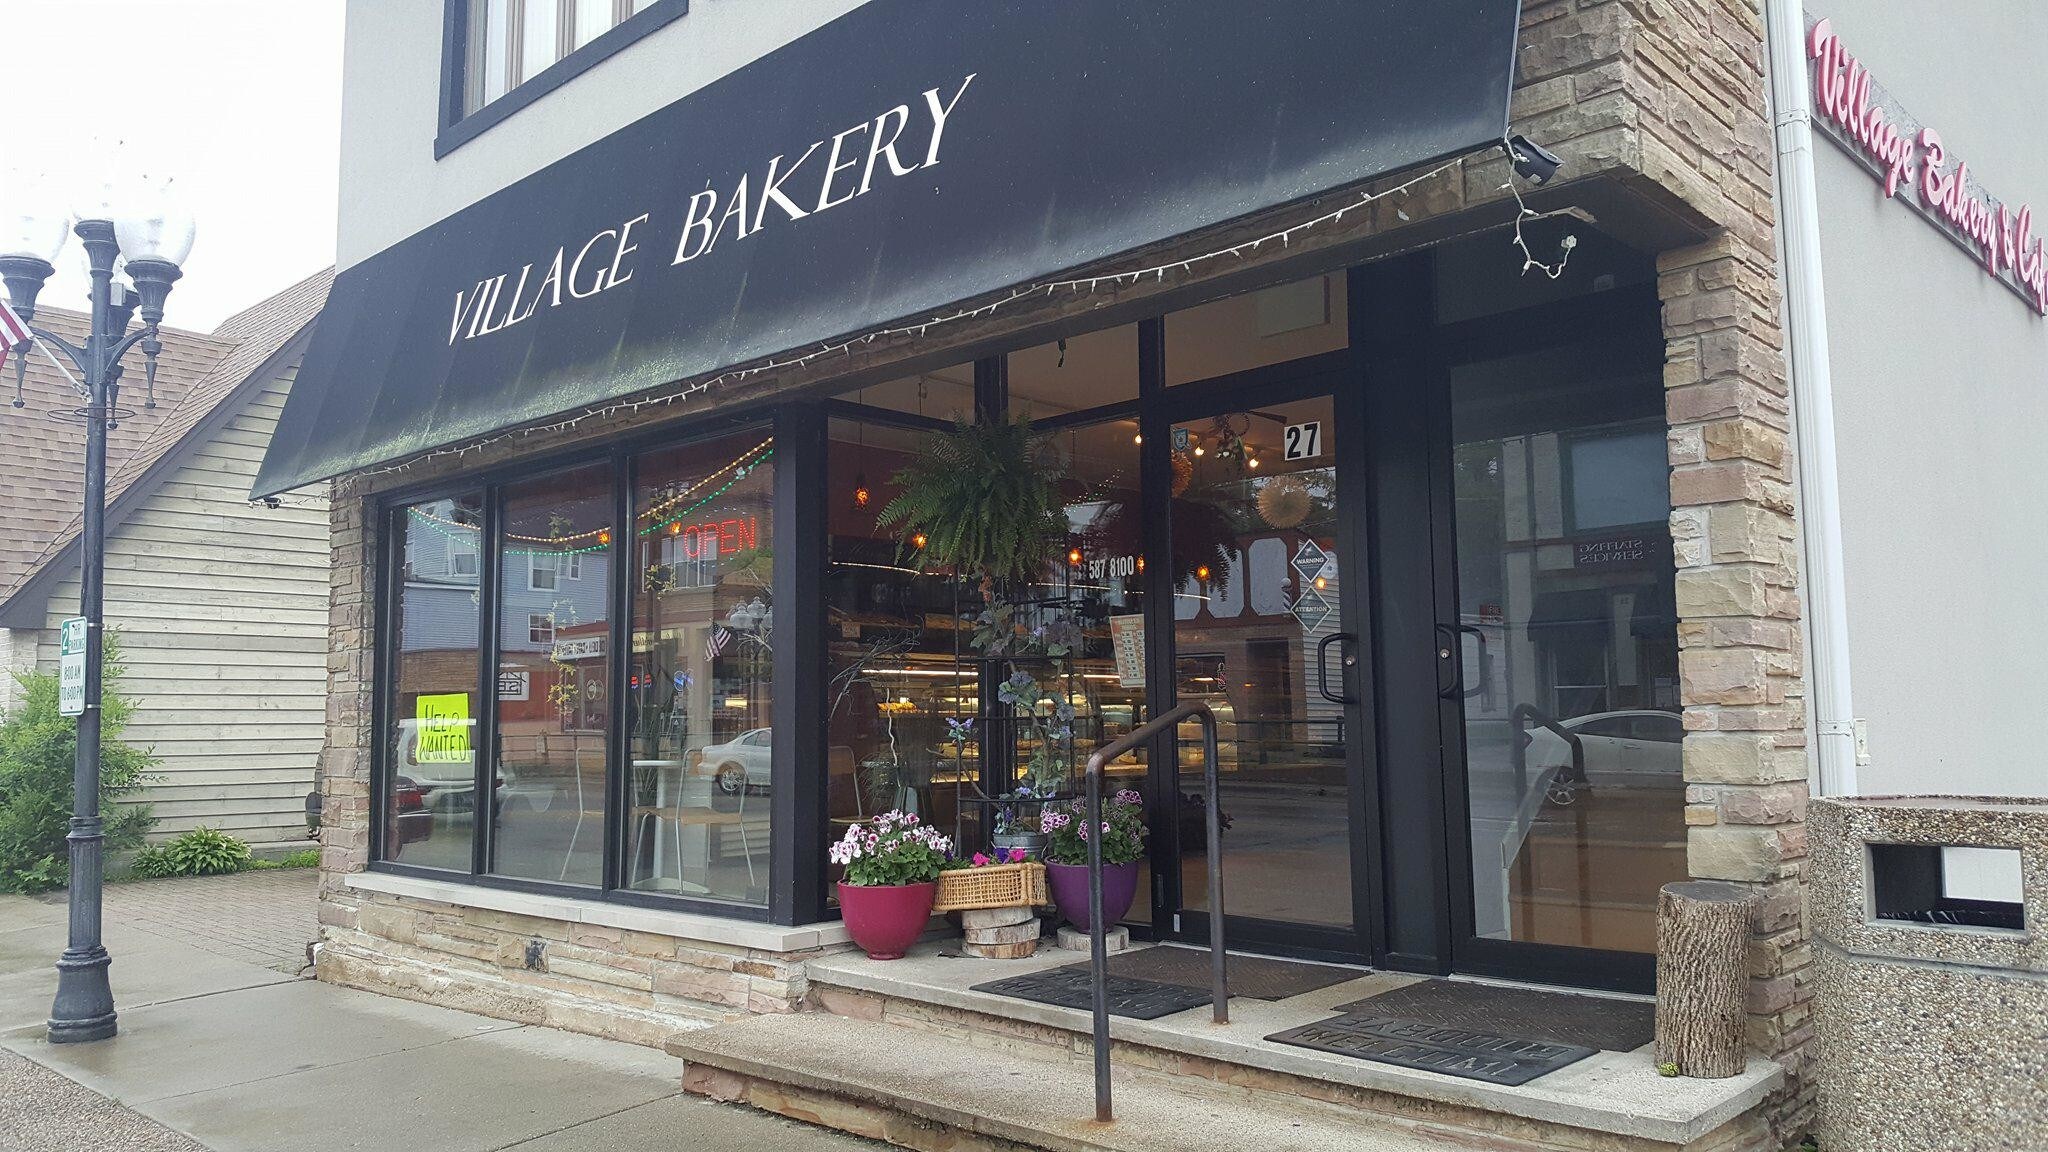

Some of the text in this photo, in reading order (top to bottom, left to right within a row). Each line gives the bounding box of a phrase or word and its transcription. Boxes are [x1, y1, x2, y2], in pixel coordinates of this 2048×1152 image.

[1809, 17, 1914, 199] Village
[1918, 127, 1998, 278] Bakery
[449, 73, 977, 347] VILLAGE BAKERY
[1286, 422, 1318, 459] 27
[684, 514, 756, 558] OPEN
[1089, 555, 1134, 579] 587 8100
[1296, 557, 1325, 565] WARNING
[1295, 605, 1328, 613] ATTENTION
[62, 627, 69, 651] 2
[69, 638, 84, 650] PARKING
[425, 705, 460, 733] HELP
[419, 735, 467, 761] WANTED
